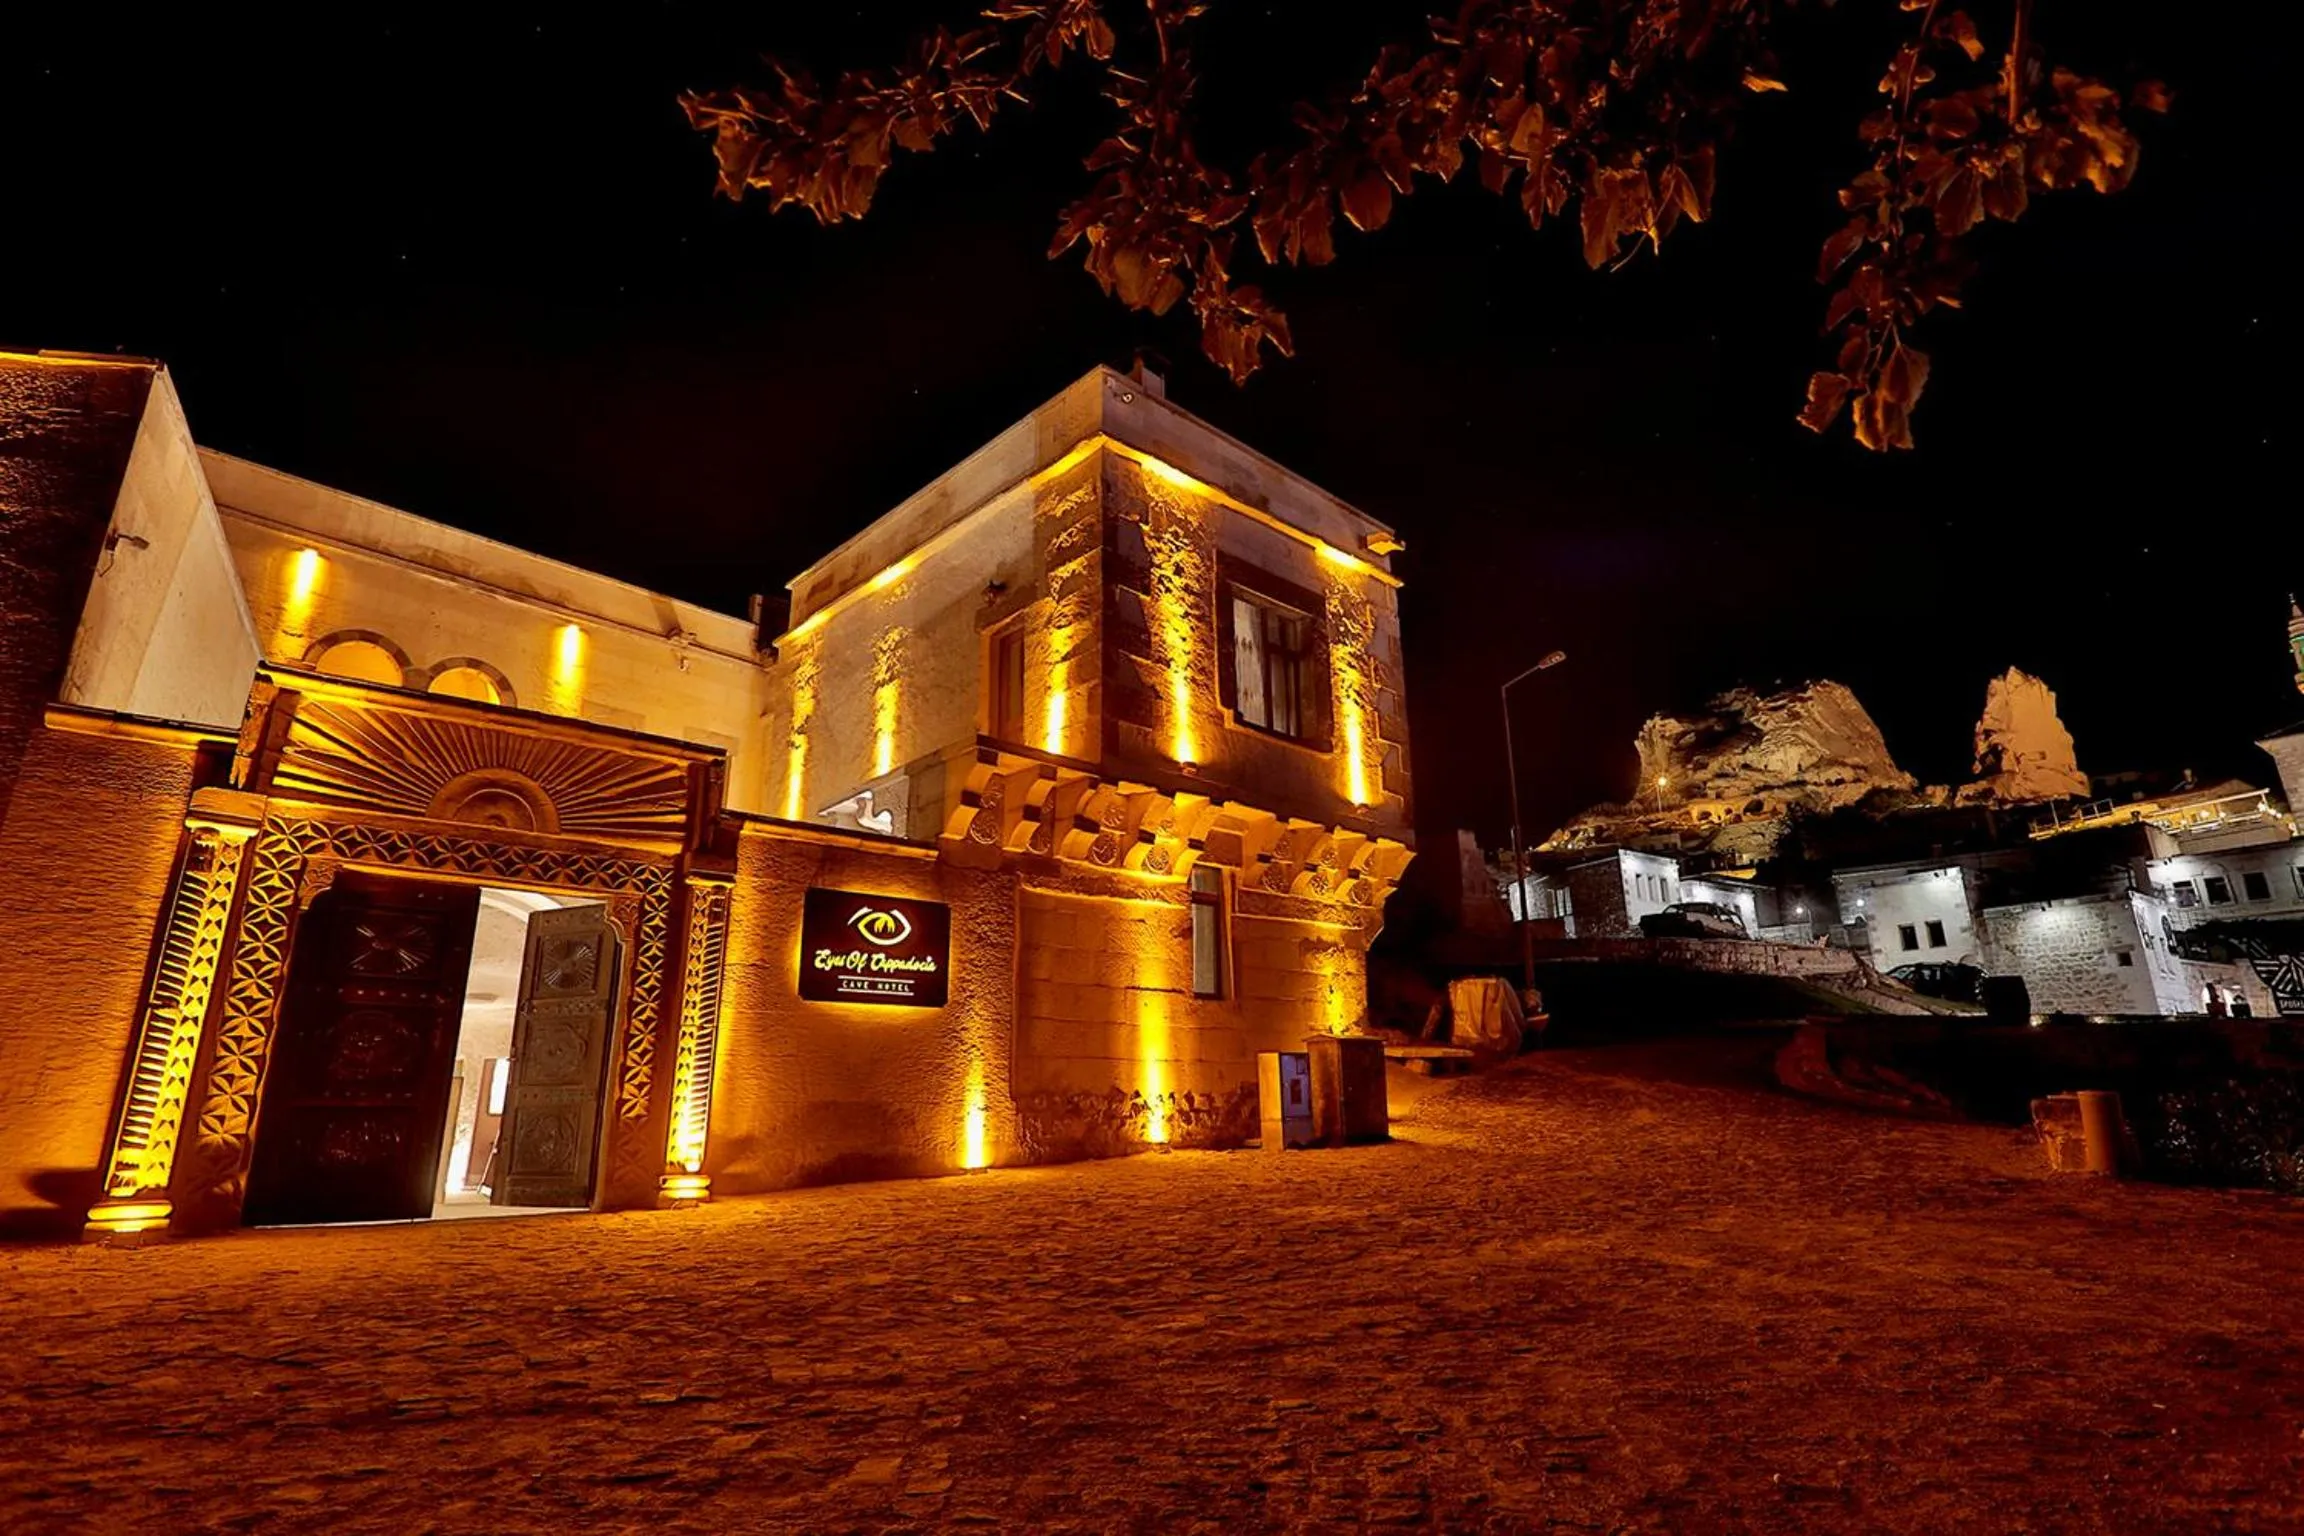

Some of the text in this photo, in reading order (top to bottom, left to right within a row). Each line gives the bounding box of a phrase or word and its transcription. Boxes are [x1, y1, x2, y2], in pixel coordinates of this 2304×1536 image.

[814, 949, 937, 973] Eyes Of Cappadocia
[842, 980, 910, 992] CAVE HOTEL
